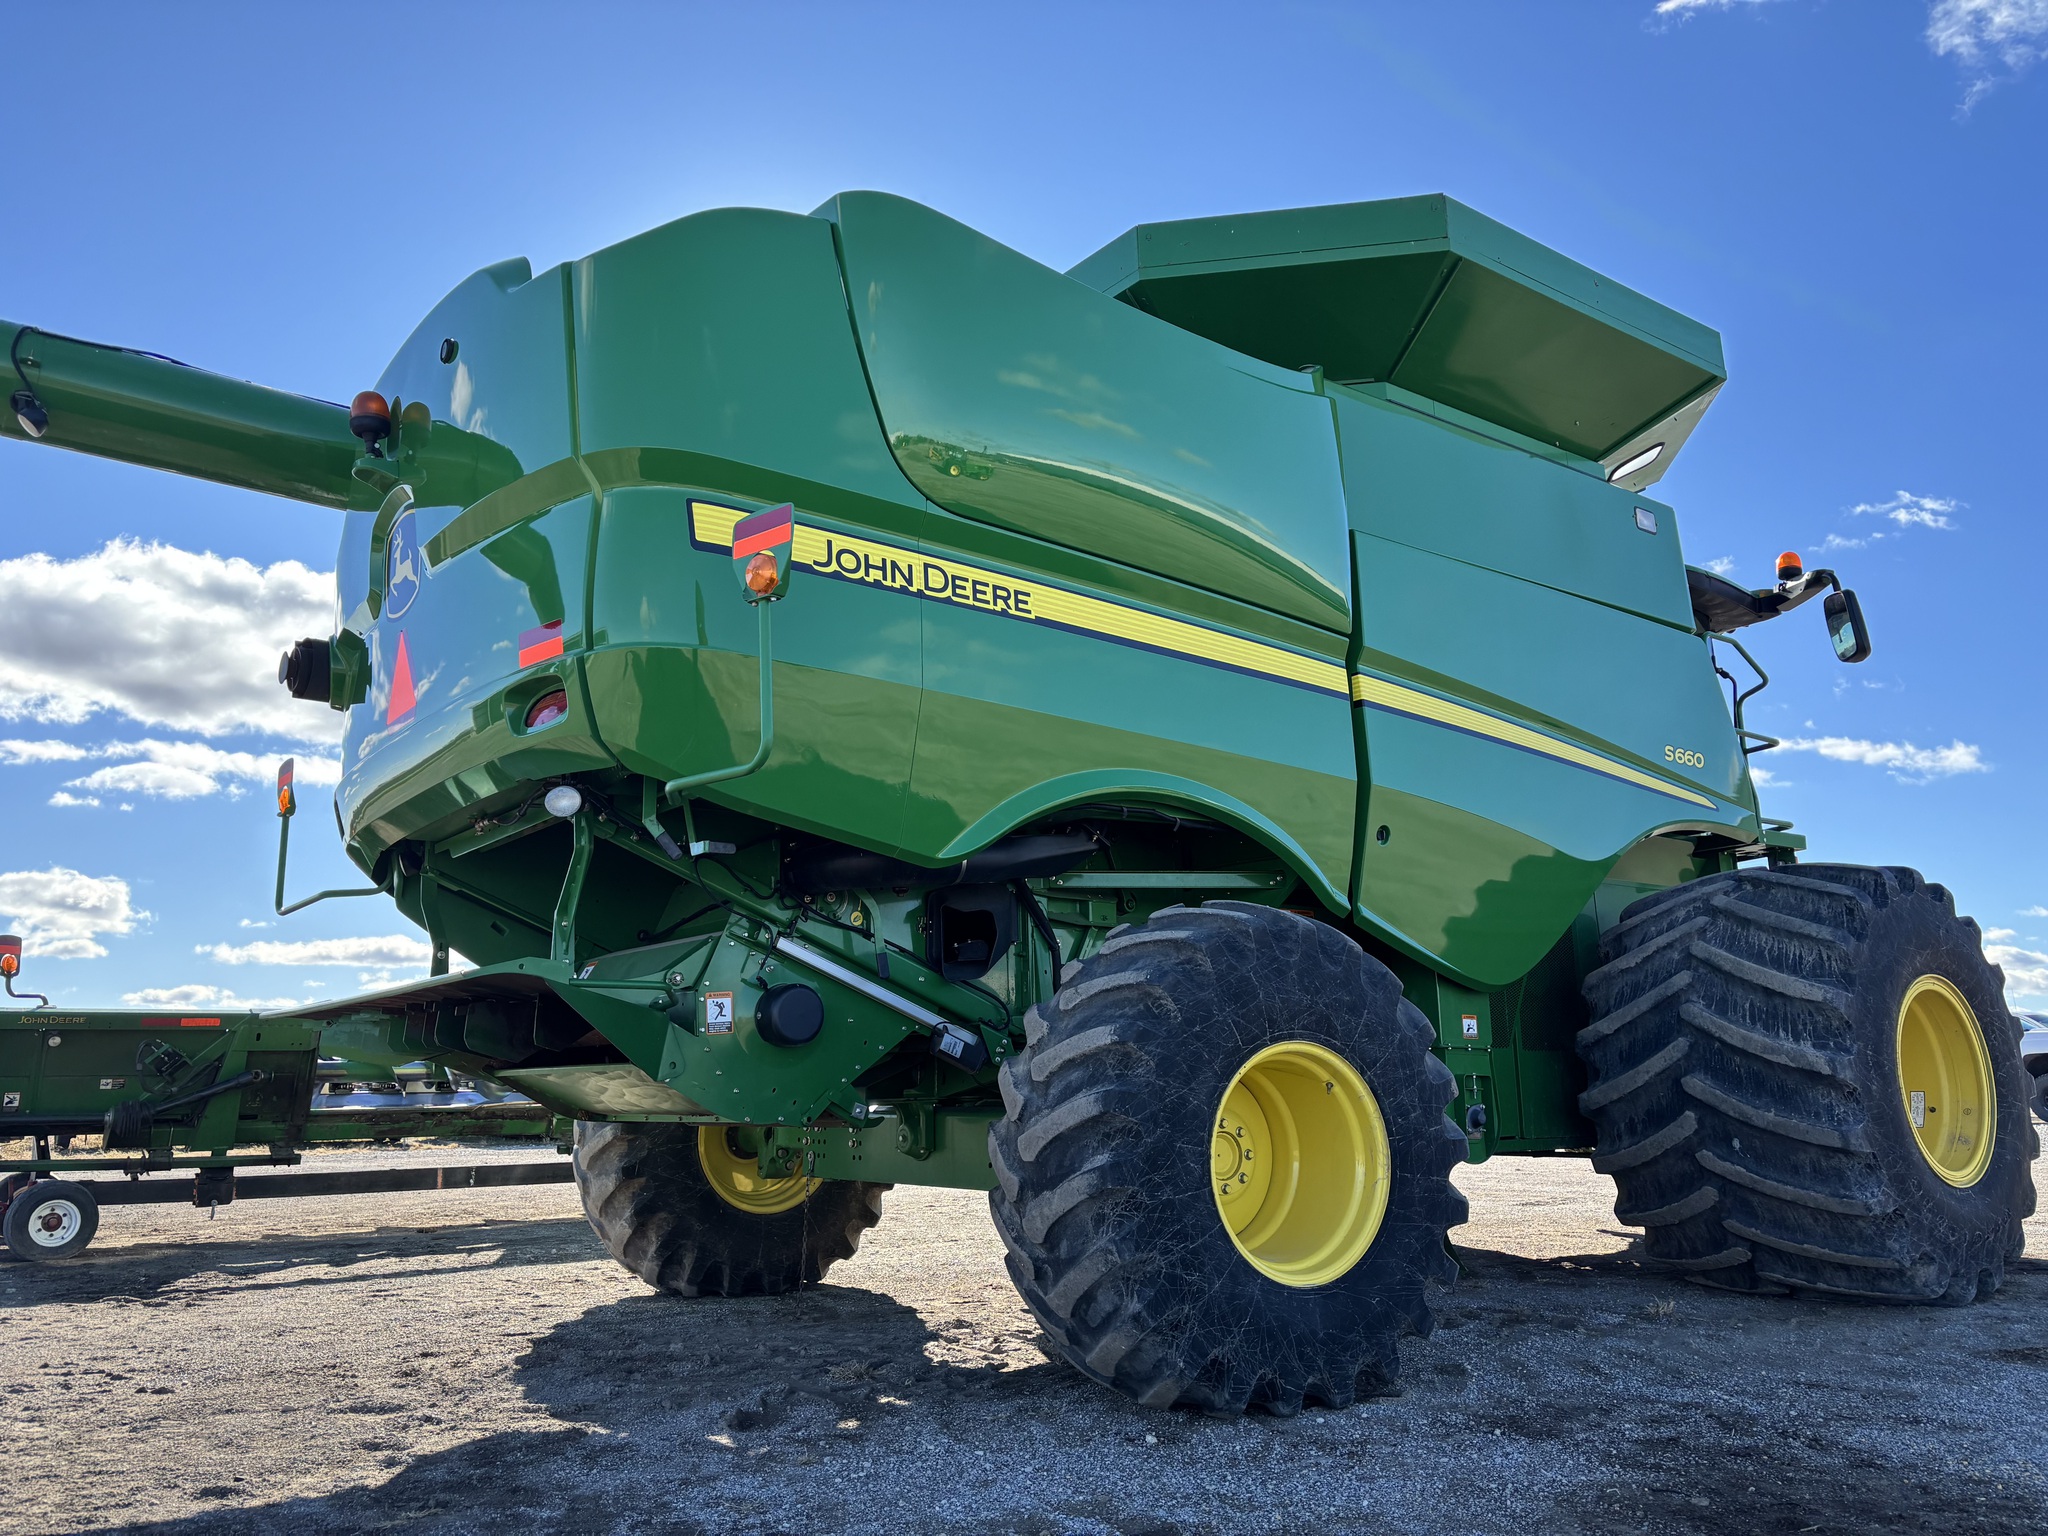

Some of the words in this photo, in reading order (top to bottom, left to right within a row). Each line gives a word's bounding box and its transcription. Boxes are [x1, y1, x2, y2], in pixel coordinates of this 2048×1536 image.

[813, 539, 914, 588] JOHN
[923, 562, 1032, 615] DEERE
[1664, 745, 1705, 769] S660
[17, 1015, 48, 1024] JOHN
[49, 1015, 87, 1024] DEERE
